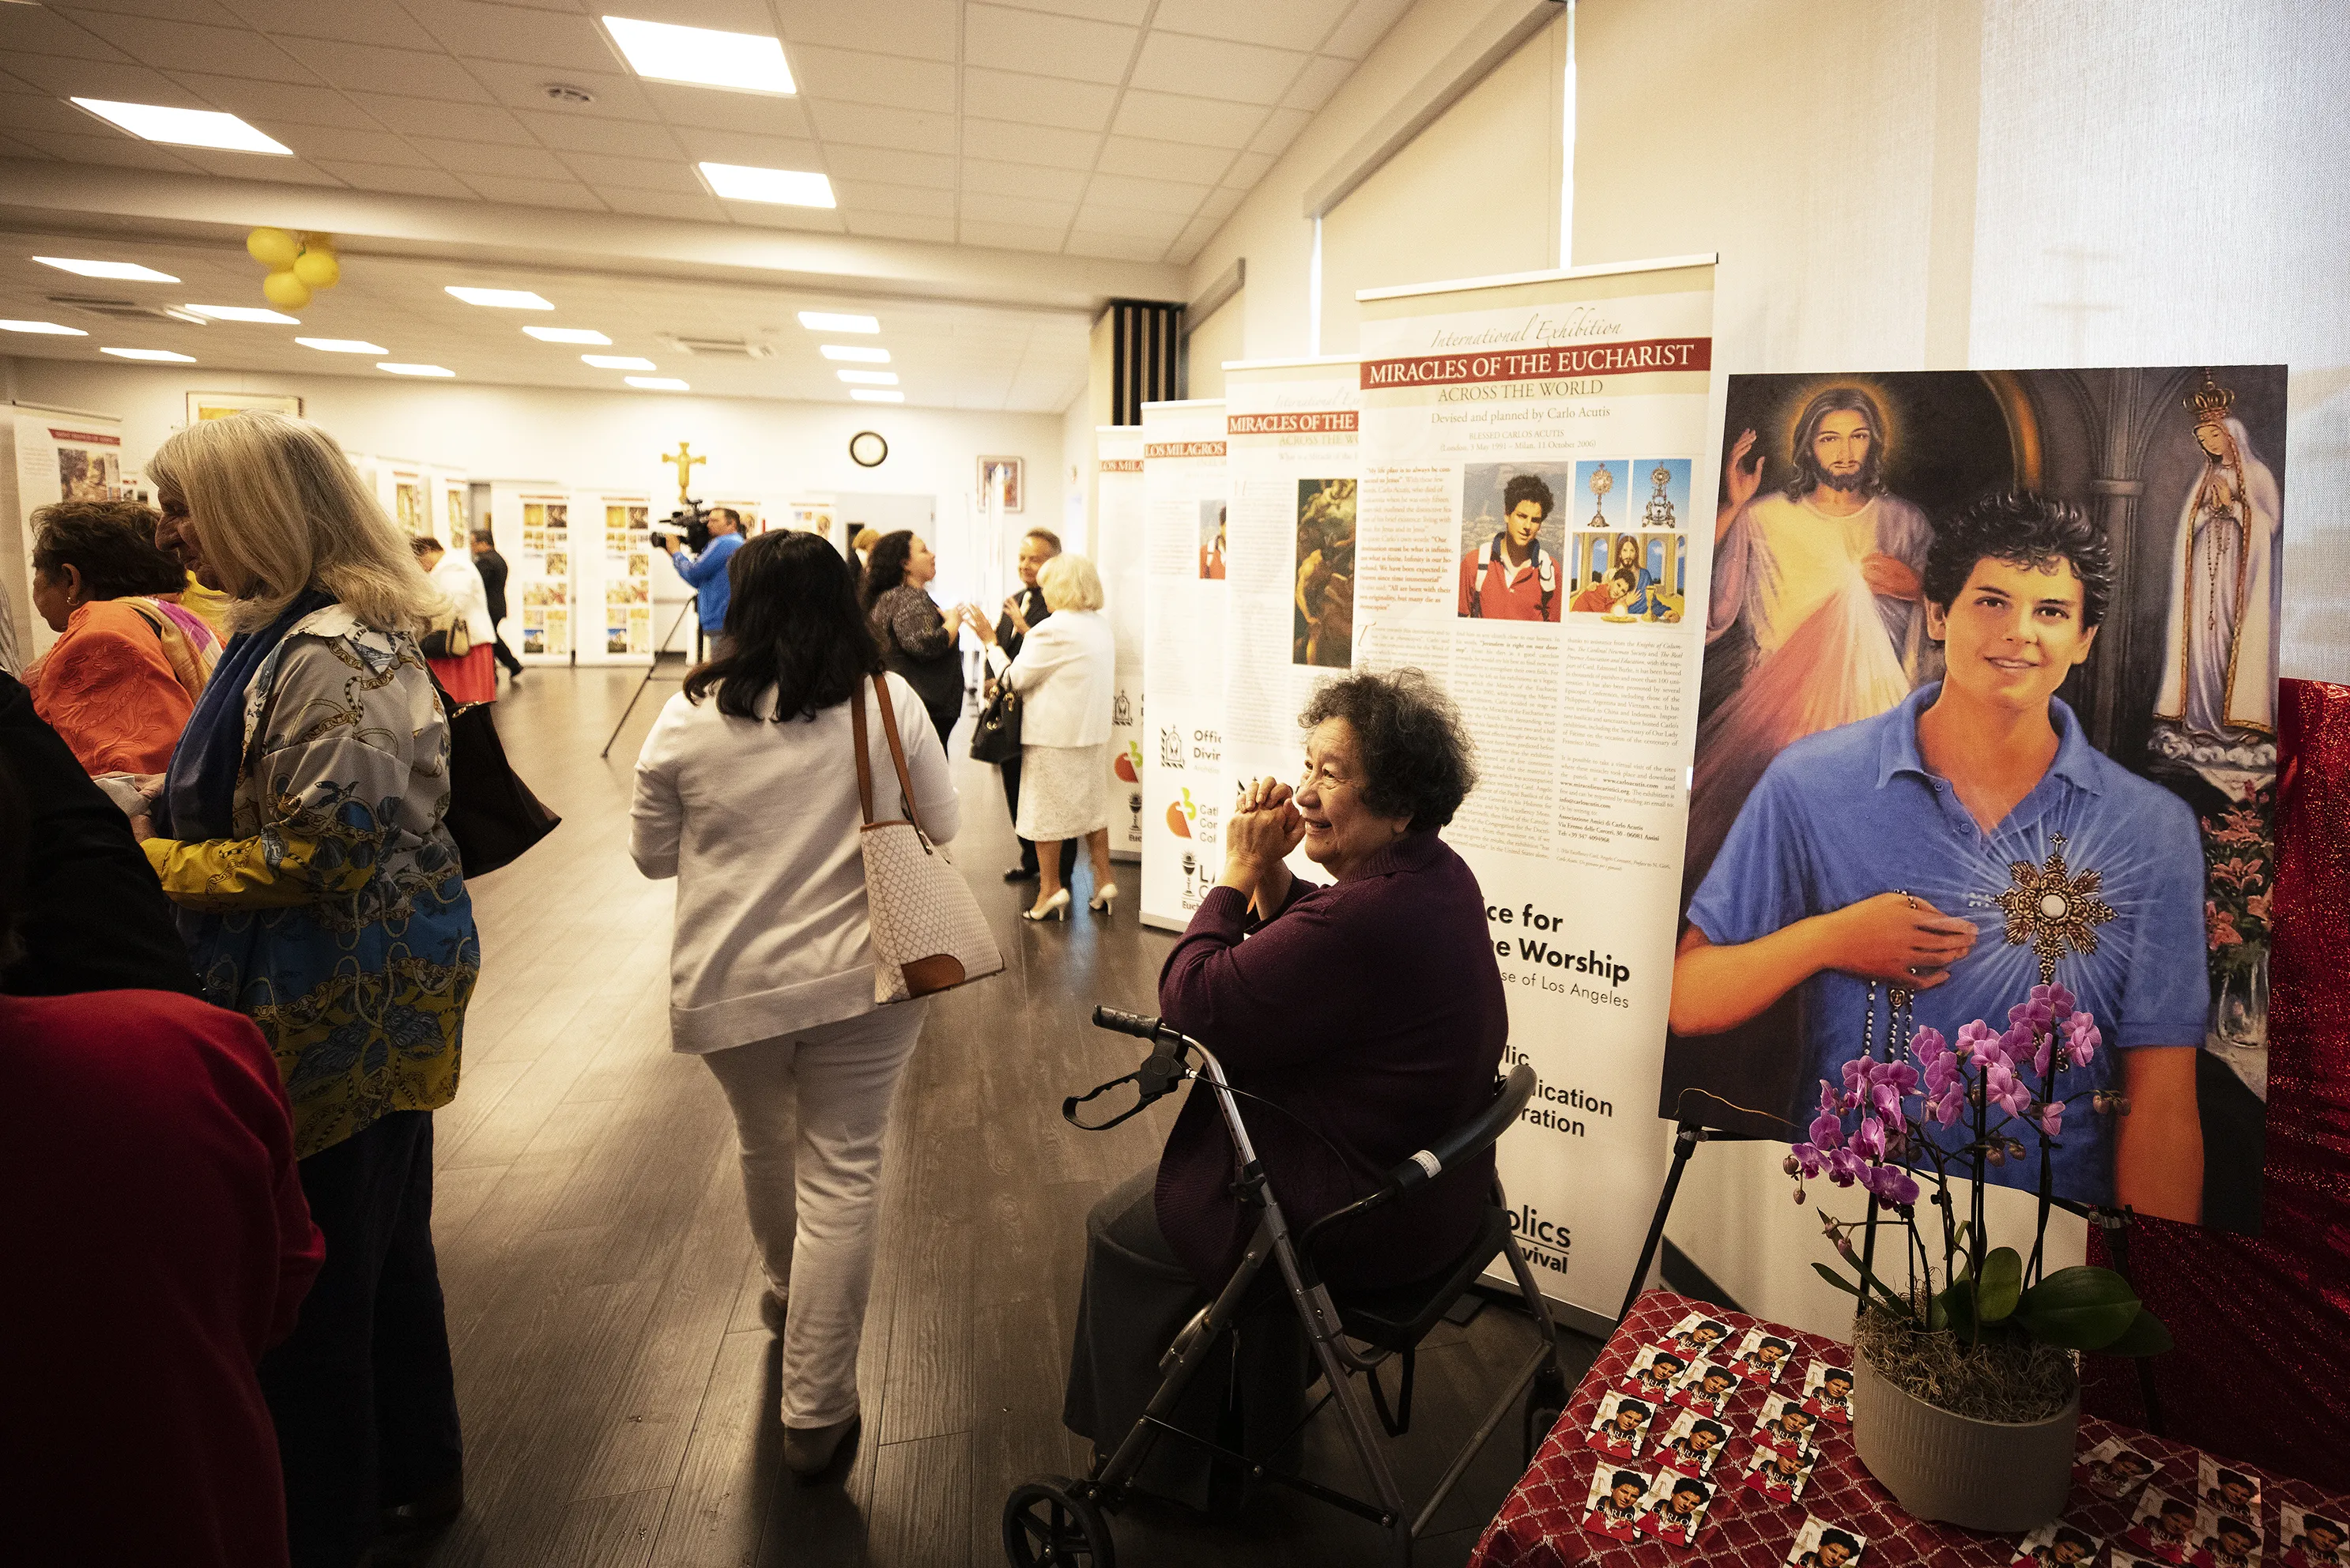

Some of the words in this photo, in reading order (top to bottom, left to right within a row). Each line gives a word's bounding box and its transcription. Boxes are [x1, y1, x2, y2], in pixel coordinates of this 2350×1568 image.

[1430, 312, 1539, 349] International
[1536, 306, 1622, 348] Exhibition
[1368, 358, 1467, 384] MIRACLES
[1472, 356, 1500, 378] OF
[1504, 352, 1552, 375] THE
[1557, 344, 1695, 372] EUCHARIST
[1438, 385, 1498, 402] ACROSS
[1502, 383, 1535, 398] THE
[1539, 379, 1603, 396] WORLD
[1229, 415, 1297, 432] MIRACLES
[1299, 414, 1320, 431] OF
[1322, 413, 1355, 430] THE
[1431, 411, 1468, 424] Devised
[1470, 410, 1488, 422] and
[1490, 409, 1529, 424] planned
[1532, 408, 1543, 422] by
[1548, 406, 1575, 419] Carlo
[1578, 405, 1611, 417] Acutis
[1279, 435, 1319, 447] ACROSS
[1322, 435, 1342, 445] THE
[1469, 431, 1500, 440] BLESSED
[1502, 429, 1532, 439] CARLOS
[1533, 428, 1564, 438] ACUTIS
[1145, 443, 1164, 456] LOS
[1166, 442, 1223, 456] MILAGROS
[1477, 443, 1490, 451] May
[1548, 440, 1575, 449] October
[1578, 439, 1596, 449] 2006)
[1100, 462, 1116, 471] LOS
[1118, 461, 1144, 471] MILA
[1522, 903, 1564, 933] for
[1518, 937, 1631, 988] Worship
[1522, 973, 1537, 987] of
[1541, 975, 1565, 993] Los
[1570, 982, 1630, 1008] Angeles
[1536, 1079, 1613, 1118] ication
[1520, 1106, 1585, 1138] ration
[1506, 1204, 1571, 1249] olics
[1522, 1246, 1567, 1275] vival
[1635, 1374, 1669, 1389] CARLO
[1600, 1426, 1635, 1442] CARLO
[1670, 1443, 1706, 1461] CARLO
[1758, 1466, 1796, 1486] CARLO
[1596, 1505, 1634, 1521] CARLO
[1651, 1506, 1689, 1526] CARLO
